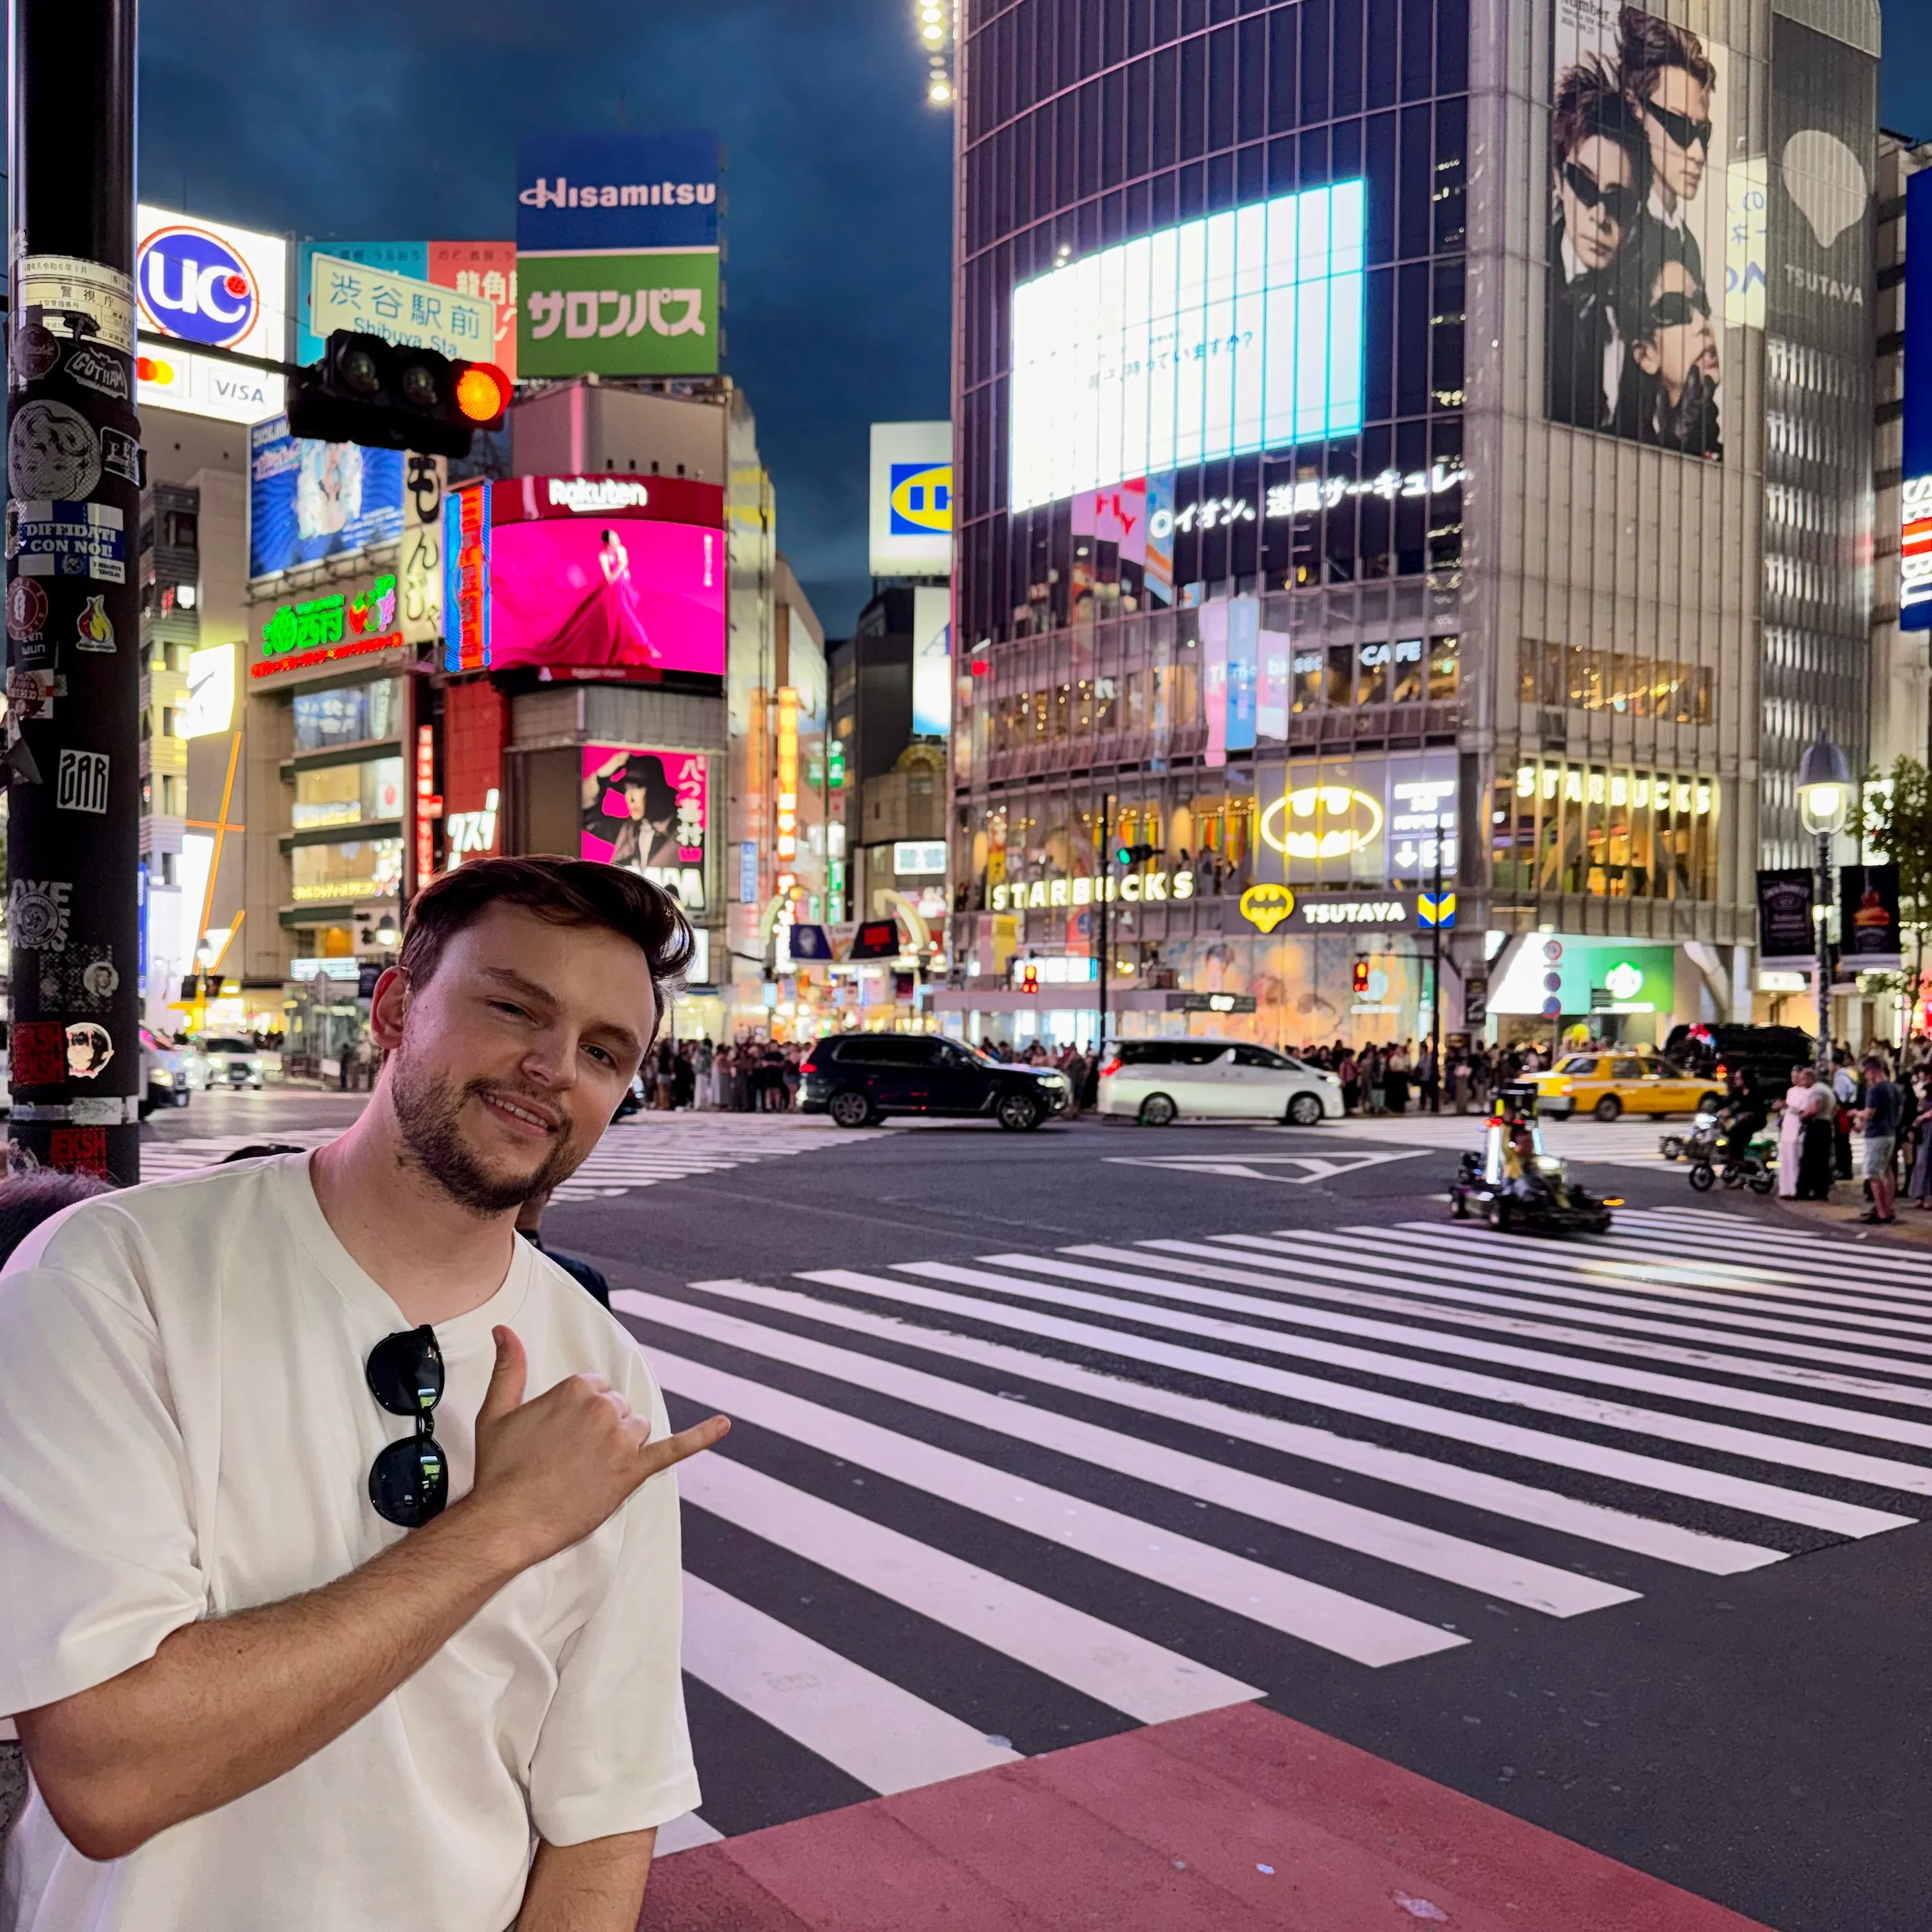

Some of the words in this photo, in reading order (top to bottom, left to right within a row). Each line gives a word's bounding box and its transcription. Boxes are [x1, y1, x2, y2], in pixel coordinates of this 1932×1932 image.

[519, 177, 716, 208] Hisamitsu
[61, 285, 114, 308] 警視庁
[1784, 263, 1864, 308] TSUTAYA
[329, 272, 480, 340] 渋谷駅前
[528, 288, 705, 340] サロンパス
[354, 317, 422, 349] Shibuya
[72, 352, 123, 388] GOTHAM
[216, 379, 264, 403] VISA
[548, 478, 648, 507] Rakuten
[26, 523, 116, 543] DIFFIDATI
[31, 540, 69, 553] CON
[74, 541, 113, 558] NOI!
[1361, 640, 1421, 666] CAFE
[1516, 766, 1712, 815] STARBUCKS
[992, 870, 1194, 911] STARBUCKS
[1302, 902, 1407, 923] TSUTAYA
